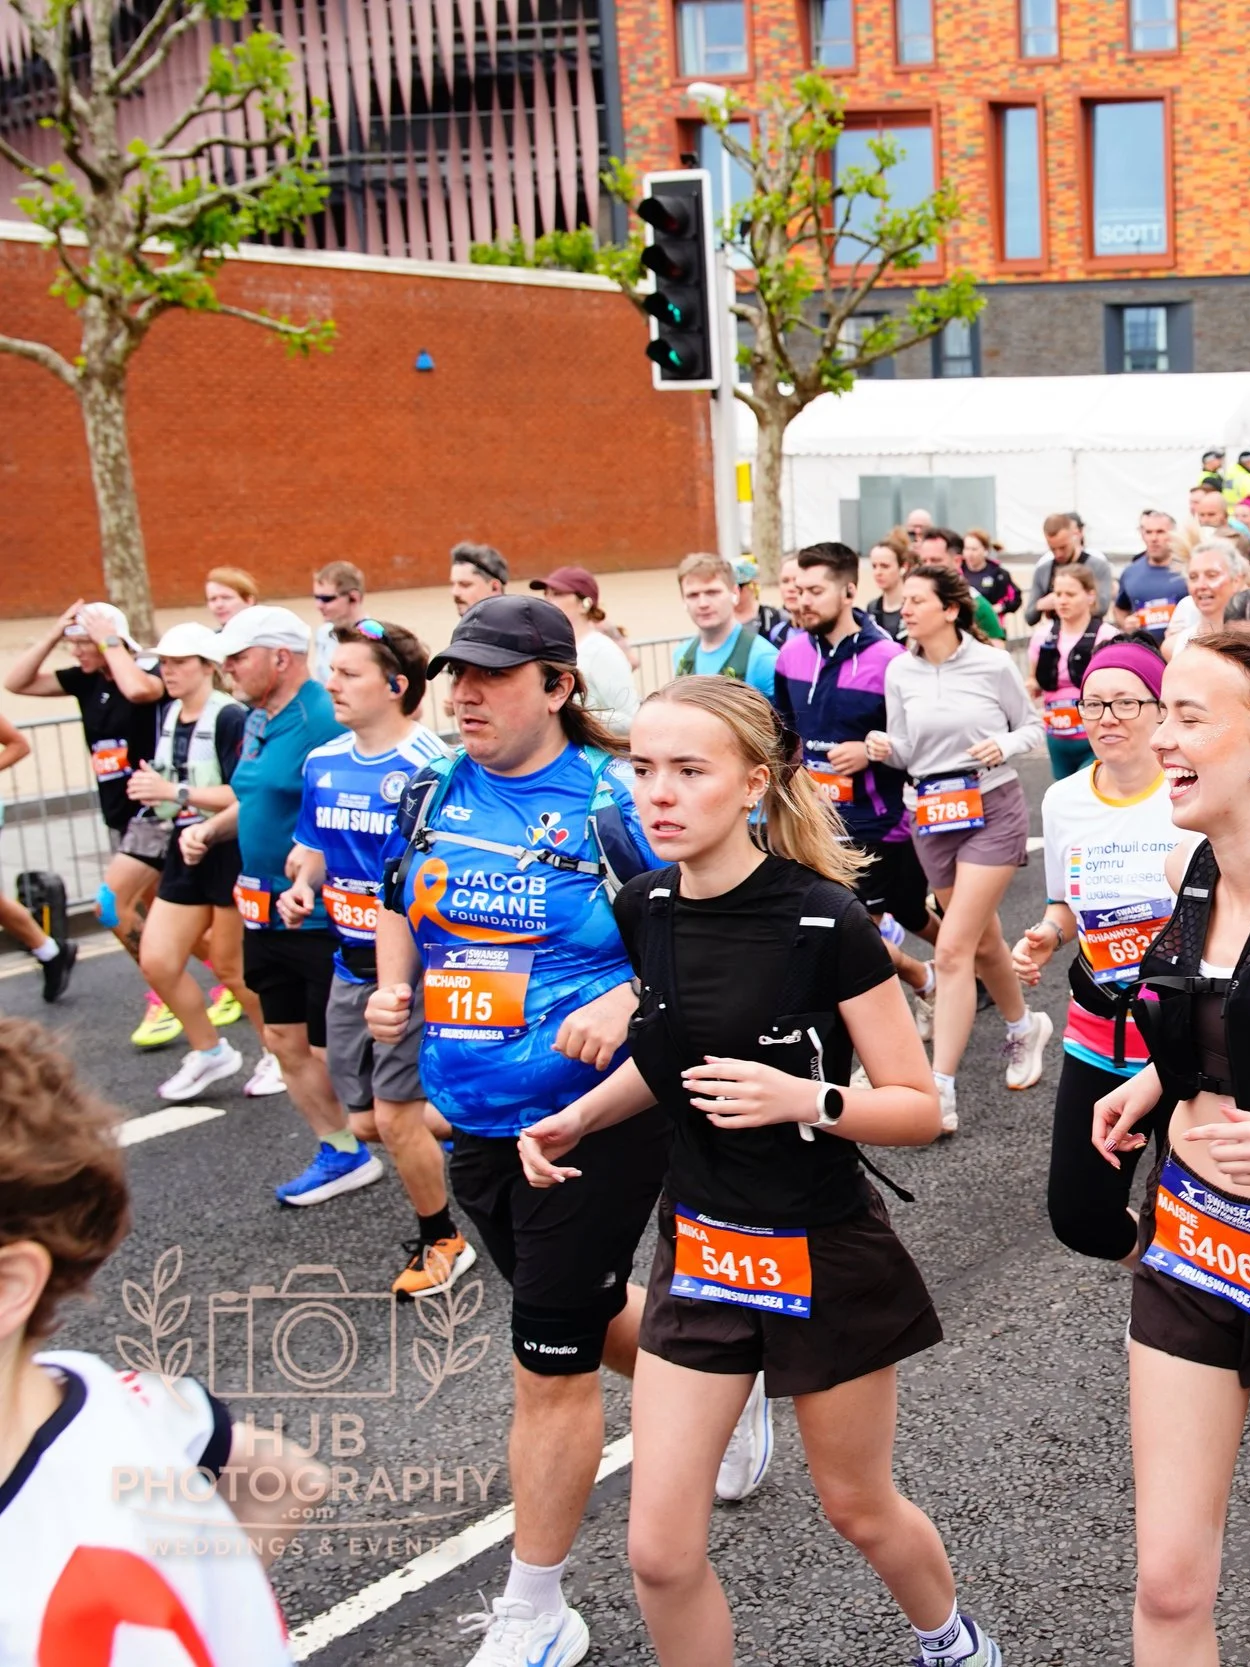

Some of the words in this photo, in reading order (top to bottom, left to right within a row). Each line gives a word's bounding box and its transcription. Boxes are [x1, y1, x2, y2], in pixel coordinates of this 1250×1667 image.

[1101, 224, 1162, 244] SCOTT
[316, 806, 396, 835] SAMSUNG
[927, 801, 969, 822] 5786
[1088, 841, 1138, 857] ymchwil
[1141, 843, 1178, 852] cans
[1086, 859, 1124, 872] cymru
[455, 869, 547, 896] JACOB
[1127, 872, 1166, 883] resear
[451, 889, 547, 918] CRANE
[1087, 889, 1120, 900] wales
[332, 902, 377, 927] 5836
[1116, 902, 1152, 916] SWANSEA
[450, 909, 547, 931] FOUNDATION
[1087, 927, 1139, 943] RHIANNON
[467, 948, 509, 960] SWANSEA
[425, 975, 471, 988] RICHARD
[448, 990, 493, 1021] 115
[1157, 1193, 1199, 1229] MAISIE
[677, 1221, 709, 1243] MIKA
[701, 1245, 782, 1286] 5413
[701, 1284, 784, 1309] #RUNSWANSEA
[539, 1344, 578, 1355] Sondico
